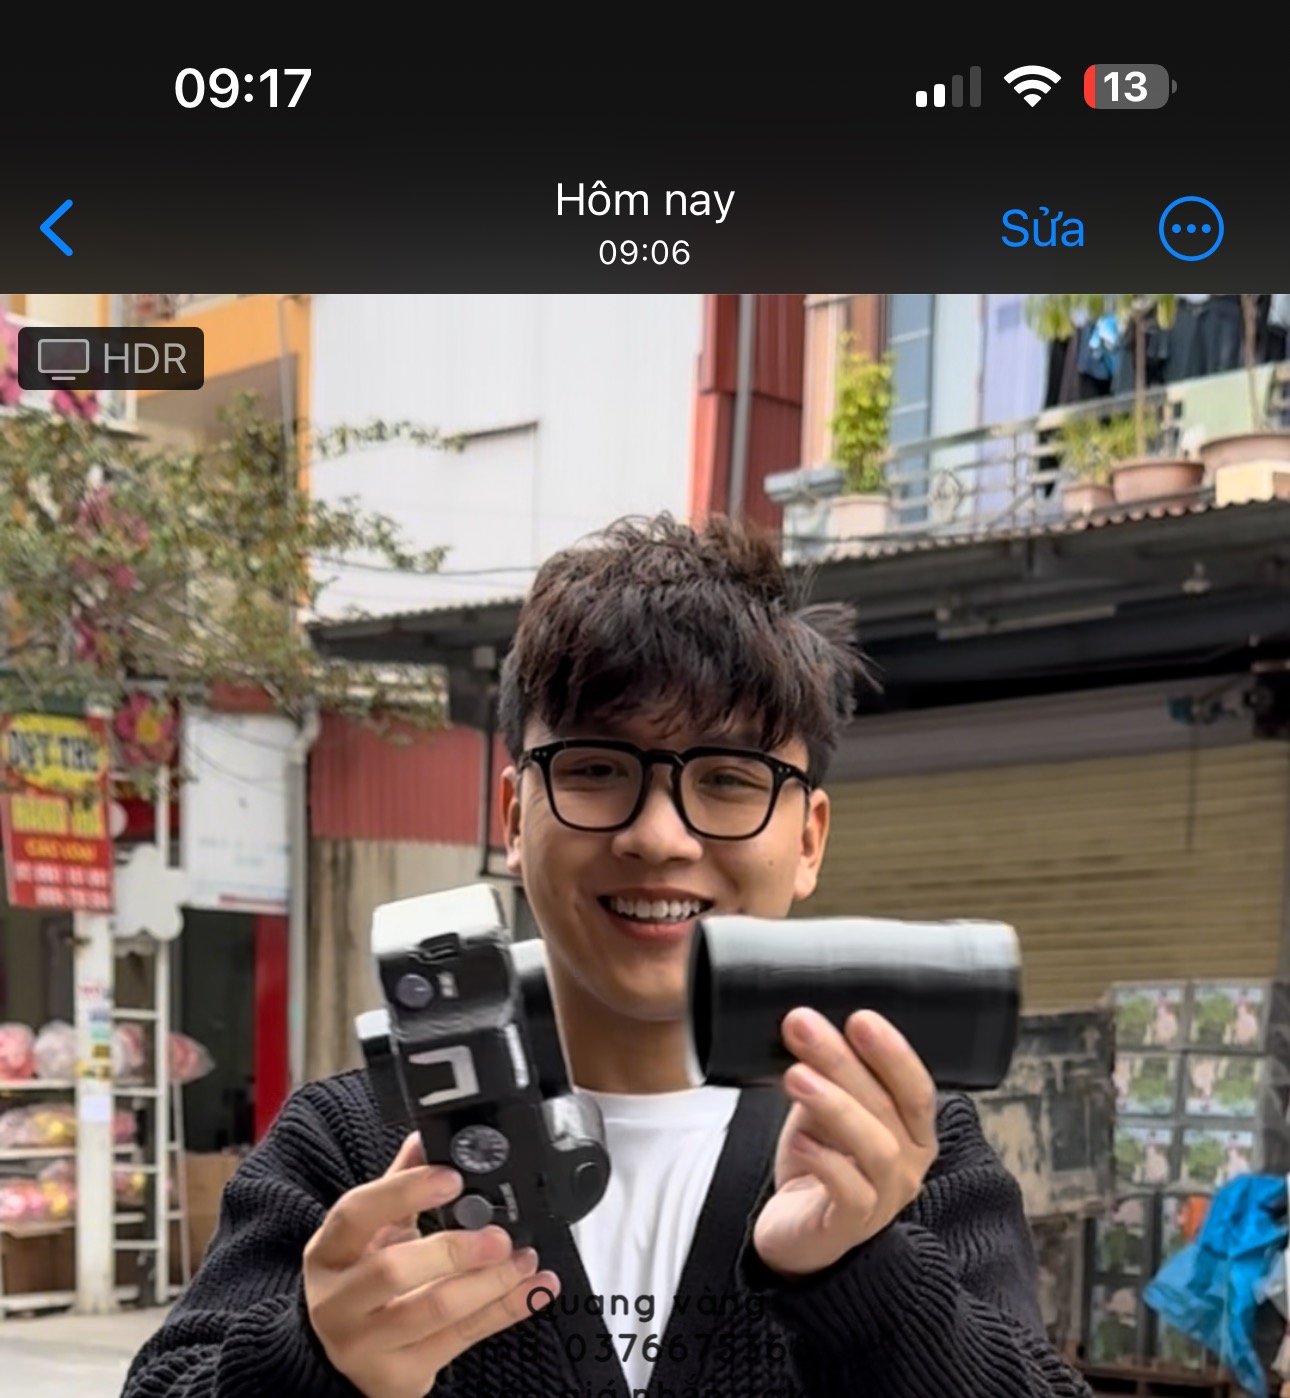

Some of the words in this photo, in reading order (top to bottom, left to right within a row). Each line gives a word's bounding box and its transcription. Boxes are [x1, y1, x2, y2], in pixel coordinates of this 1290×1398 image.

[174, 67, 312, 109] 09:17
[1104, 70, 1148, 103] 13
[557, 179, 649, 217] Hôm
[665, 187, 736, 224] nay
[1001, 206, 1085, 248] Sửa
[599, 239, 690, 266] 09:06
[104, 342, 187, 374] HDR
